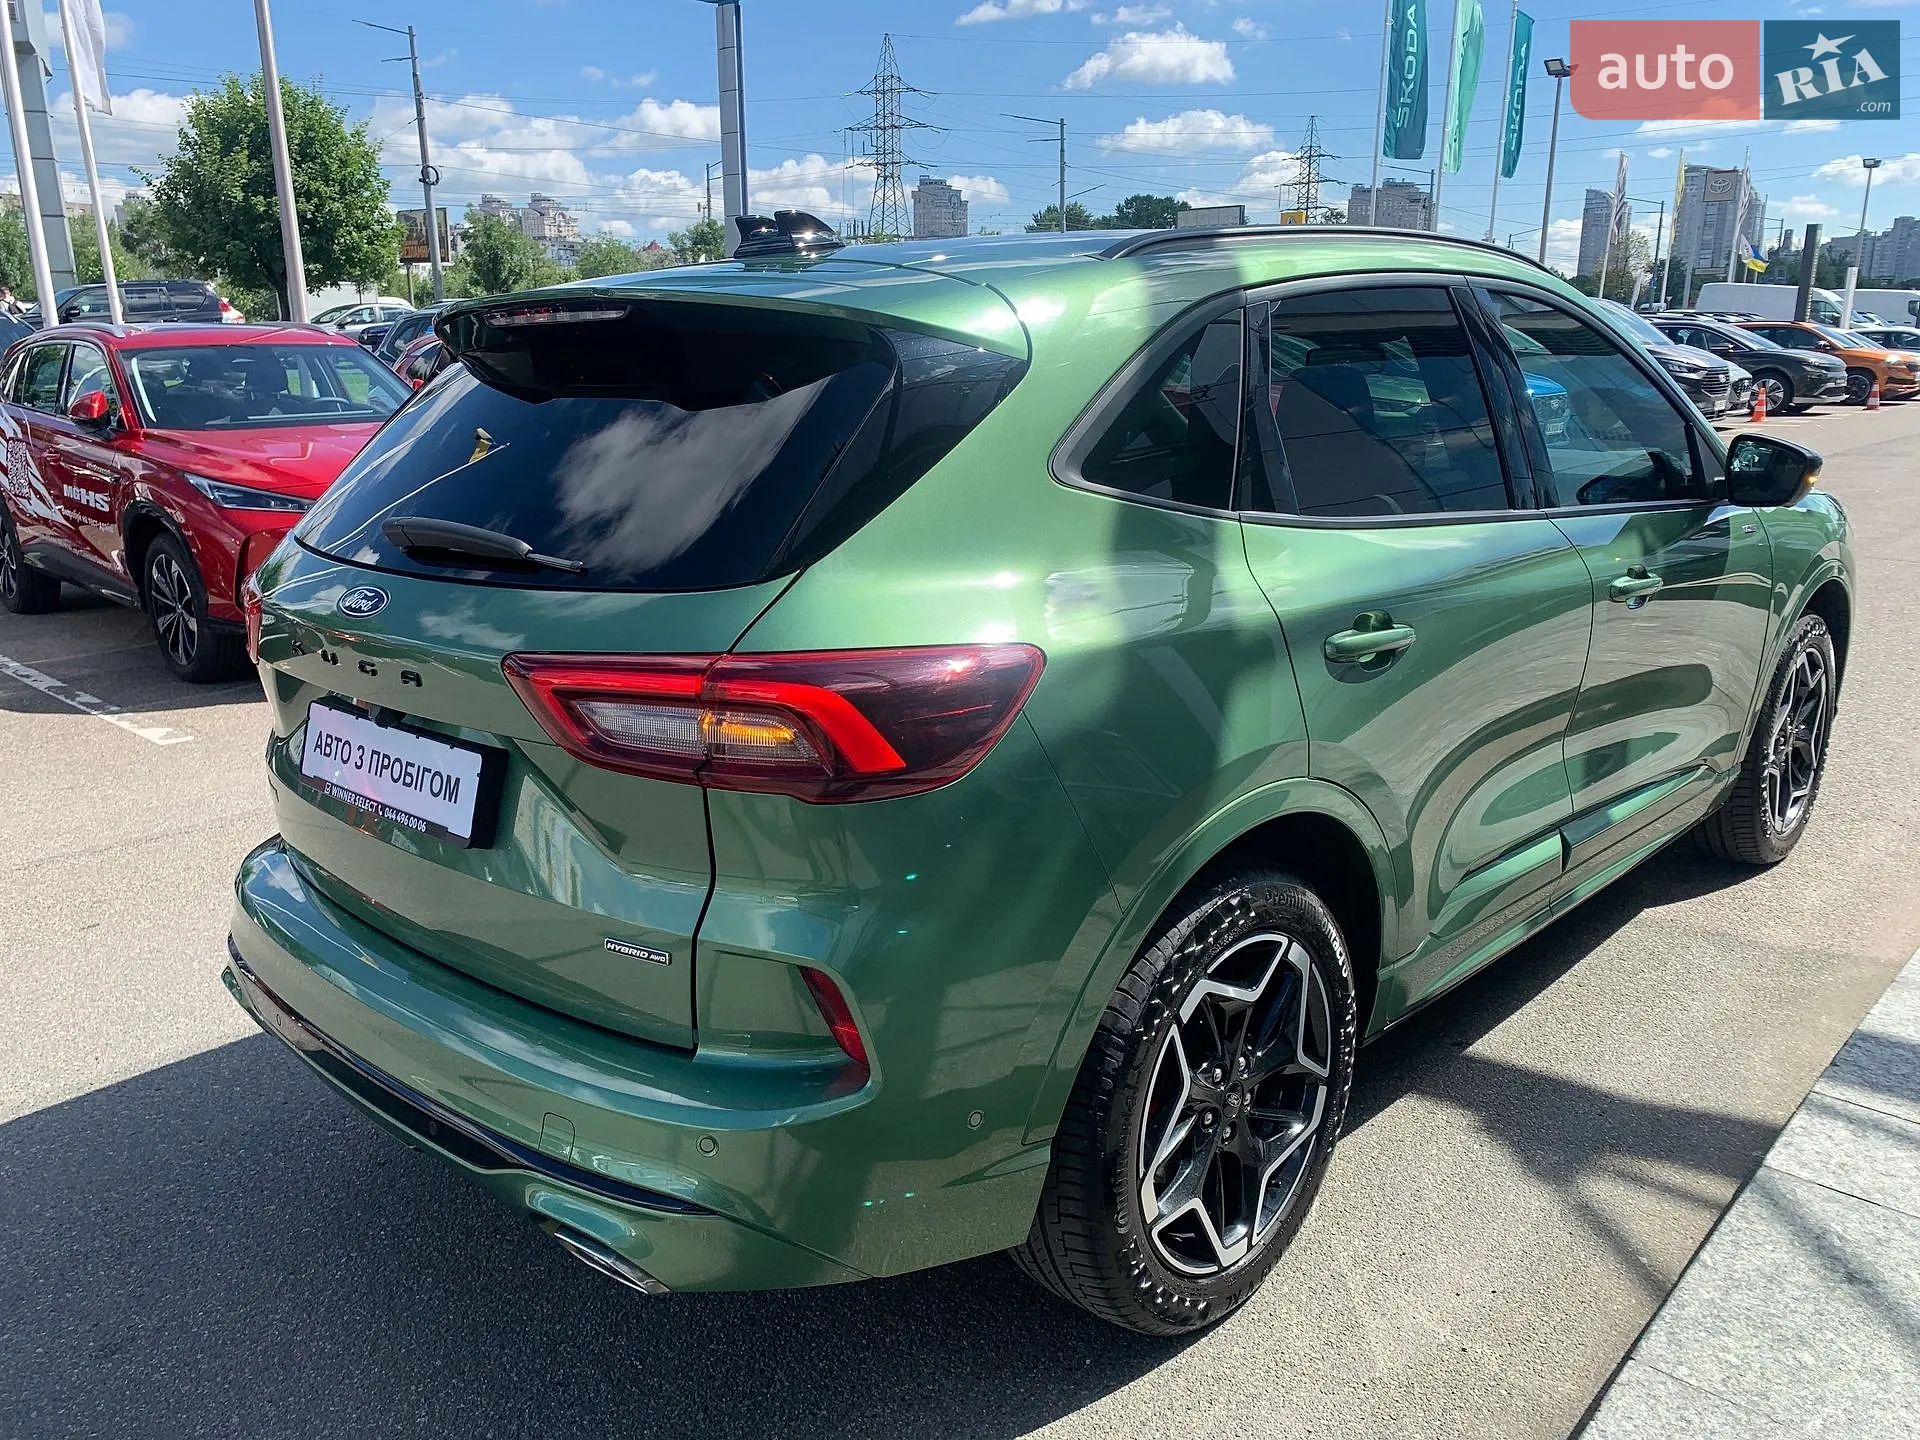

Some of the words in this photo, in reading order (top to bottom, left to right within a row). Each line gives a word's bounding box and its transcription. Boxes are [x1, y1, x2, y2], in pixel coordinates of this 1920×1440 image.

[345, 590, 378, 611] Ford
[291, 639, 424, 688] KUGA
[313, 730, 352, 765] АВТО
[368, 749, 461, 804] ПРОБІГОМ
[331, 785, 355, 805] WINNER
[355, 796, 378, 813] SELECT
[384, 807, 396, 821] 044
[396, 812, 408, 826] 496
[408, 816, 418, 829] 00
[417, 819, 427, 832] 06
[606, 942, 648, 958] HYBRID
[649, 954, 666, 963] AWD
